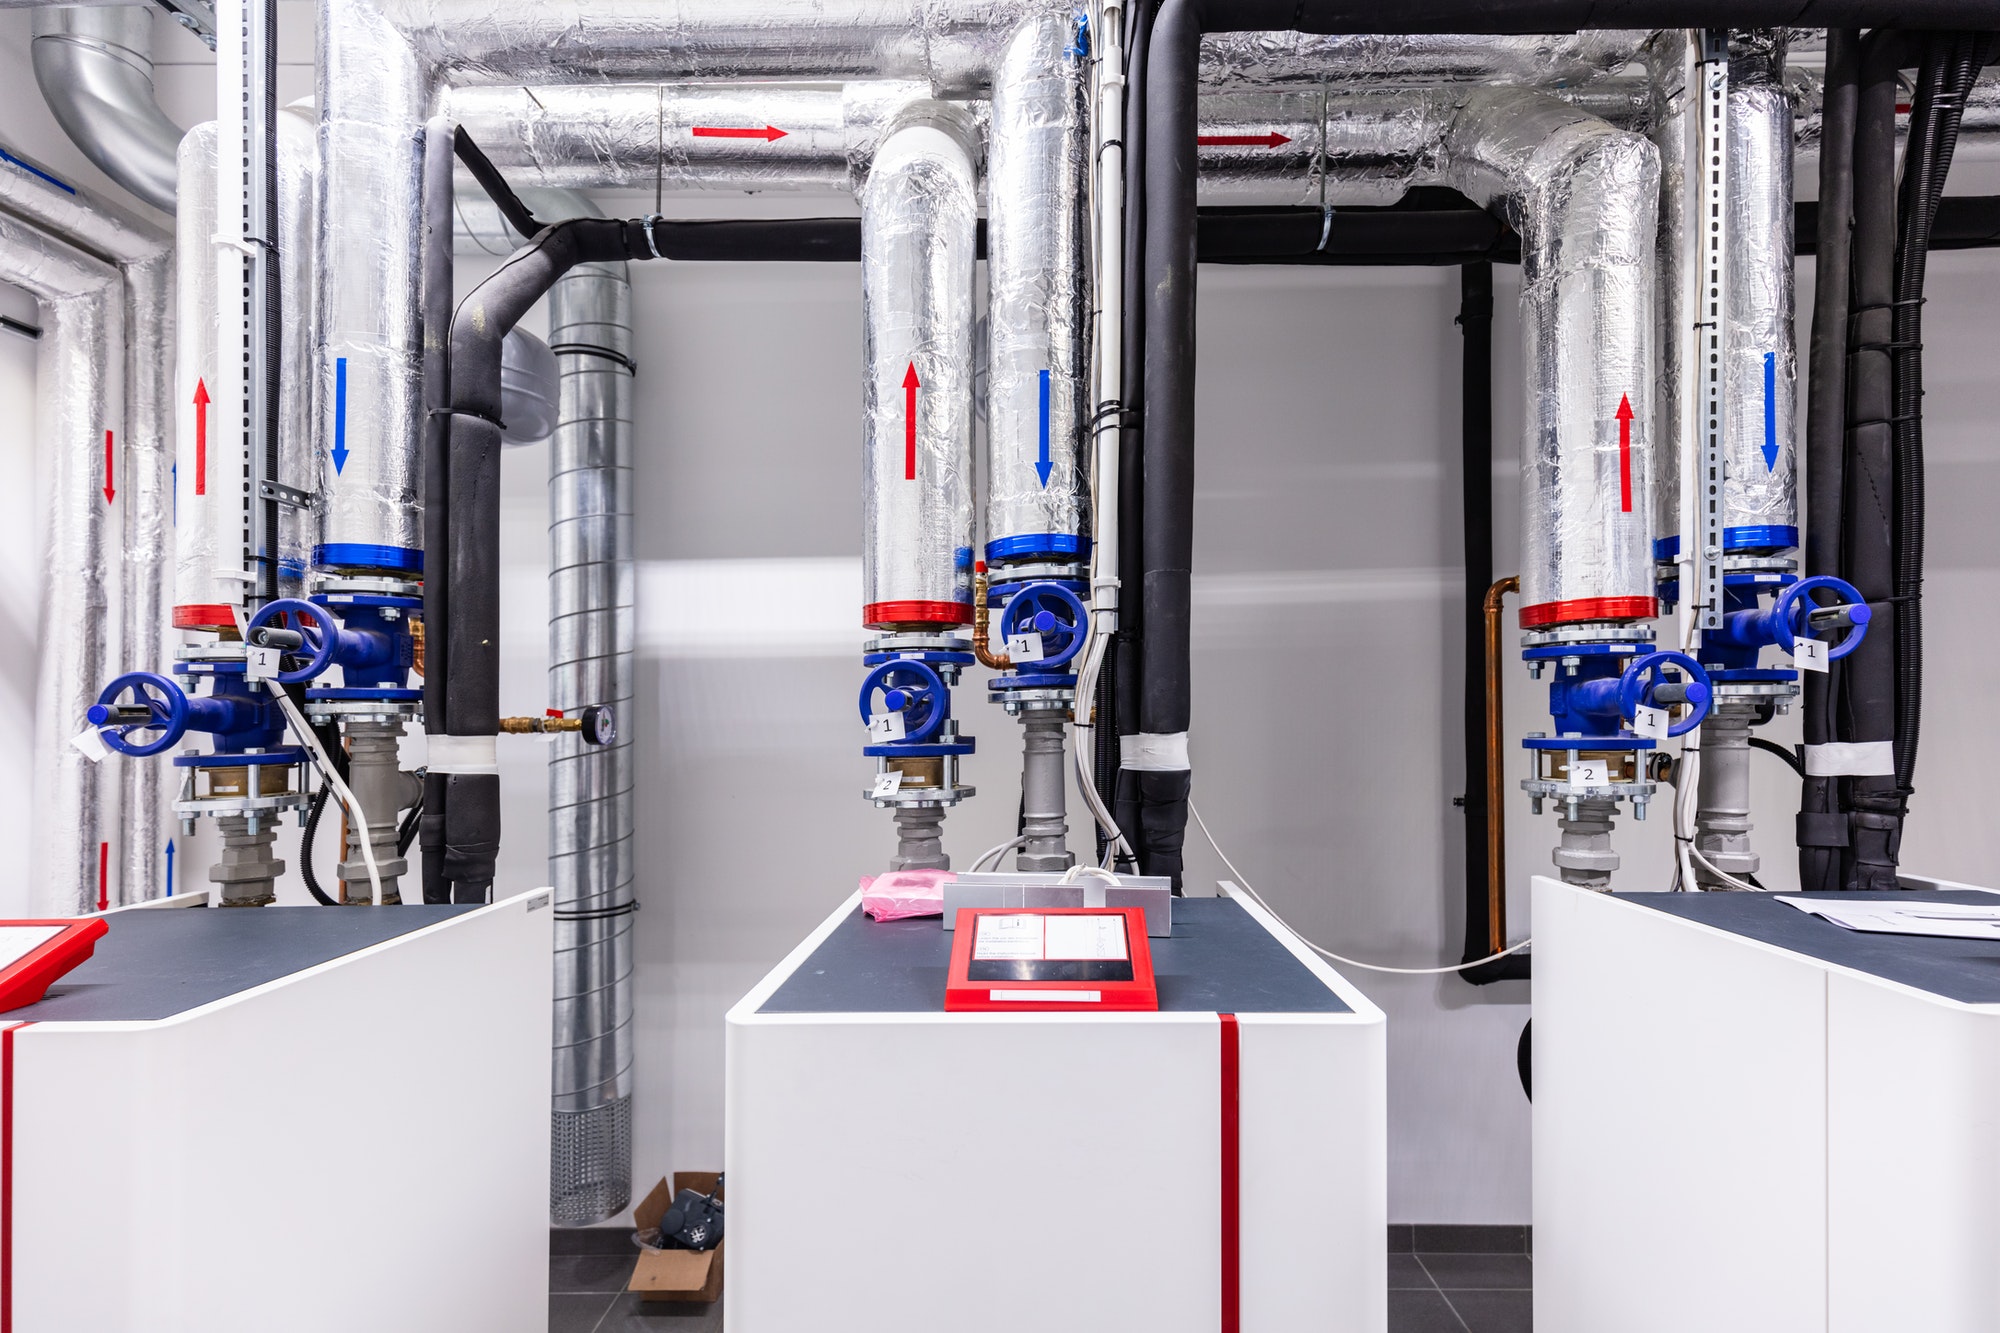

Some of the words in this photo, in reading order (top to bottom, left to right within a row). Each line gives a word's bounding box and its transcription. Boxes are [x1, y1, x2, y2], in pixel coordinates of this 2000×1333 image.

[1020, 639, 1031, 653] 1
[1807, 644, 1816, 659] 1
[258, 652, 267, 666] 1
[883, 718, 893, 733] 1
[1647, 713, 1656, 727] 1
[1584, 768, 1594, 780] 2
[882, 780, 892, 790] 2
